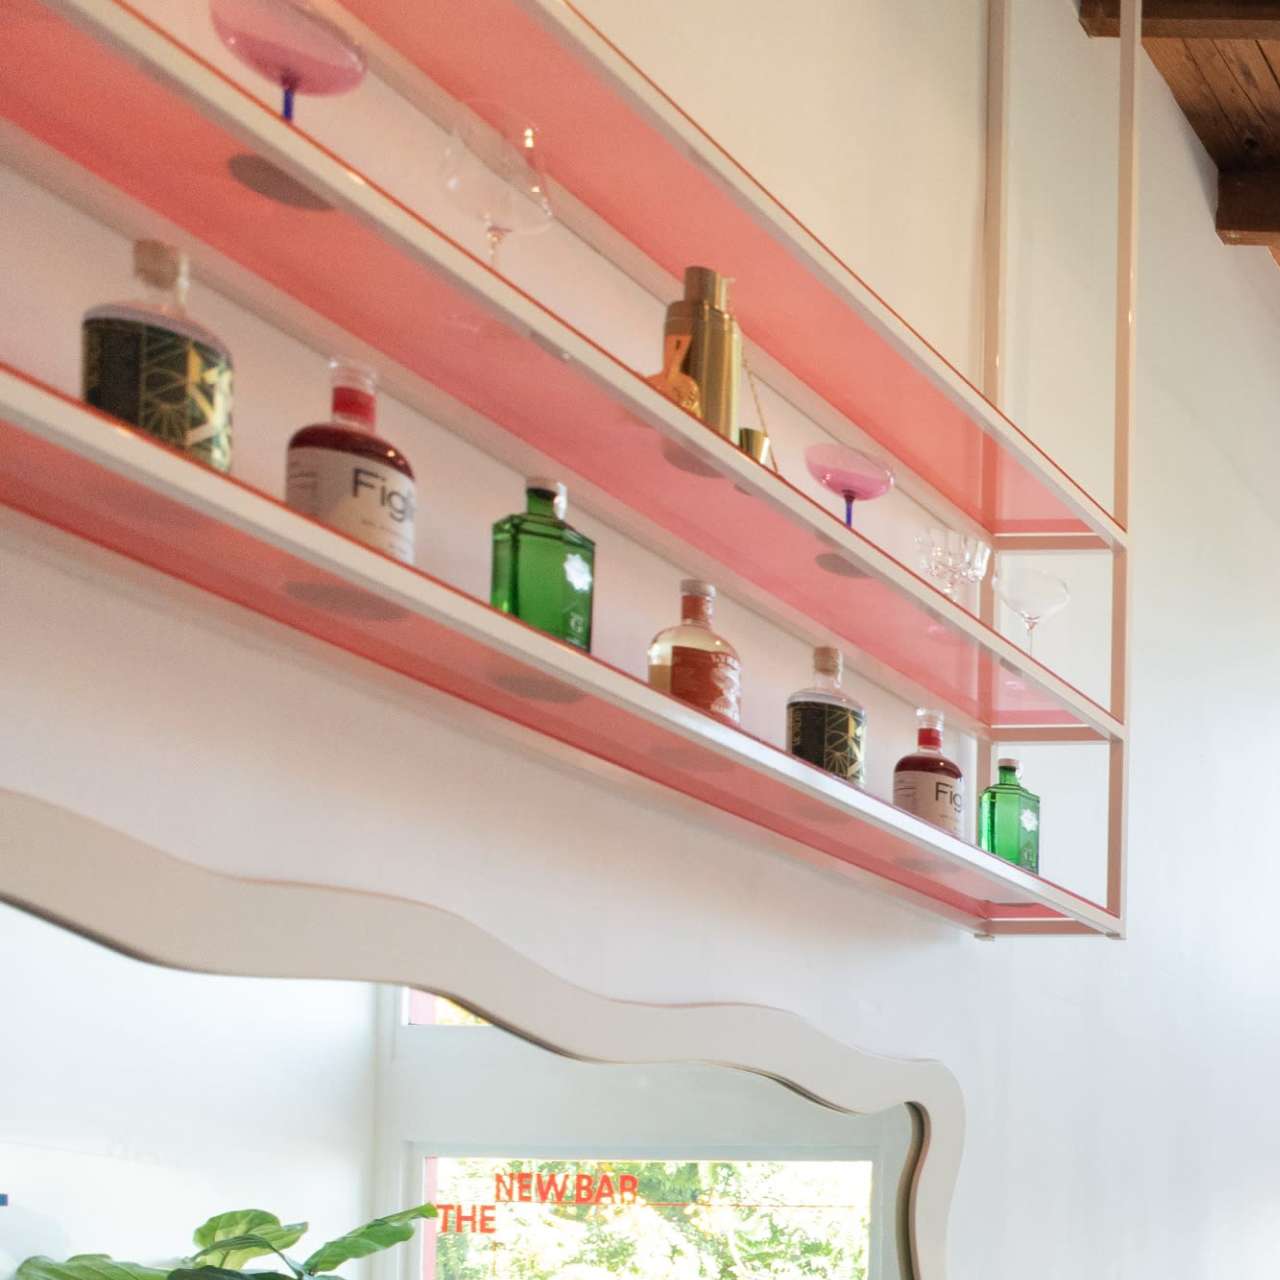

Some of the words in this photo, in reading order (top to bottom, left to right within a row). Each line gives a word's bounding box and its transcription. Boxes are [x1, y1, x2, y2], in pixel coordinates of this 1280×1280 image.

[495, 1172, 569, 1204] NEW
[575, 1174, 638, 1205] BAR
[436, 1204, 496, 1234] THE
